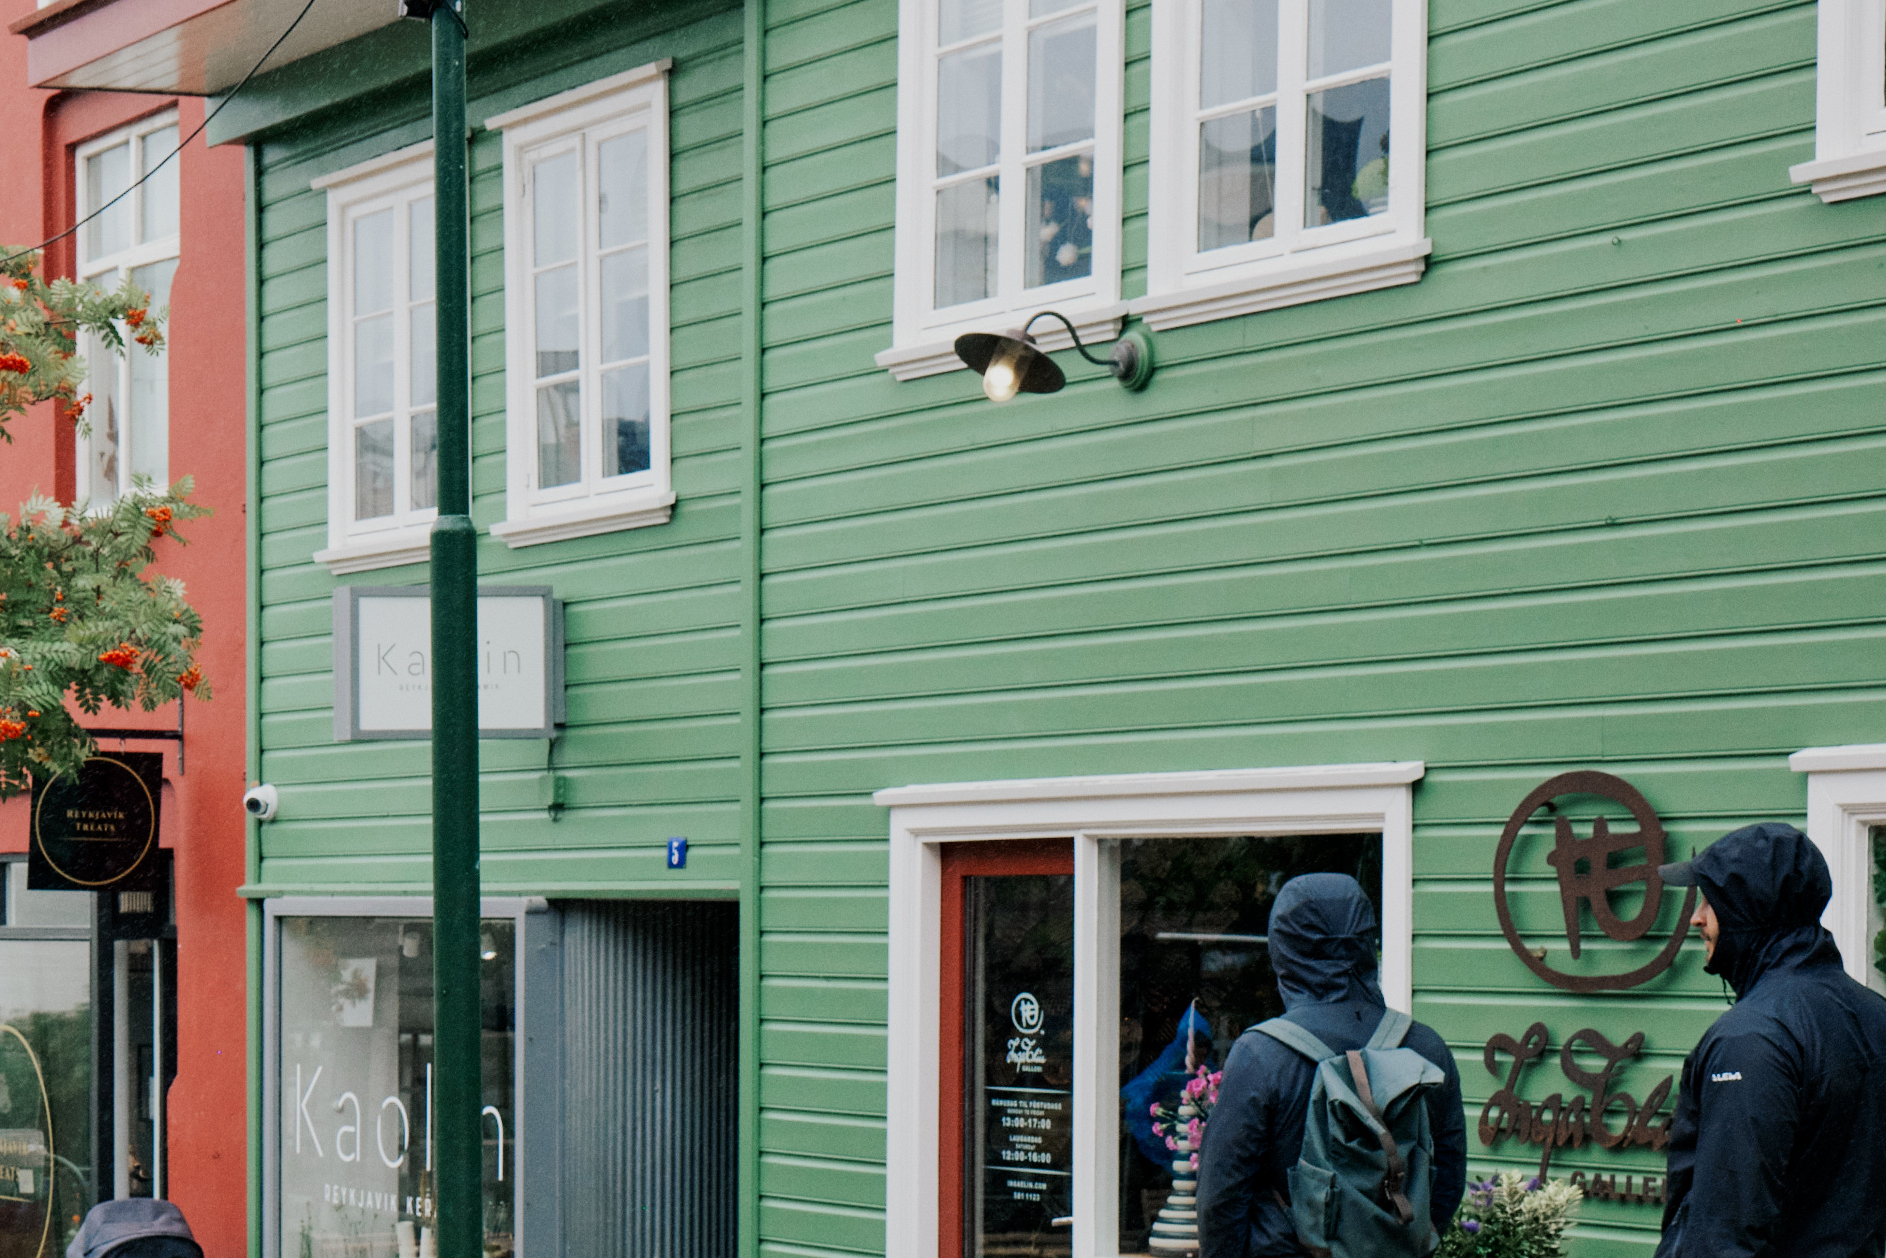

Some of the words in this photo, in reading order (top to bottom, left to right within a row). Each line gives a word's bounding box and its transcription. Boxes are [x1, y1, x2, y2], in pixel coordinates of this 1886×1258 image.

[377, 641, 521, 677] Kain
[671, 841, 679, 865] 5
[295, 1062, 504, 1182] Kaoln
[1002, 1116, 1051, 1130] 13:00-17:00
[1002, 1149, 1051, 1164] 12:00-16:00
[1570, 1170, 1667, 1201] GALLE
